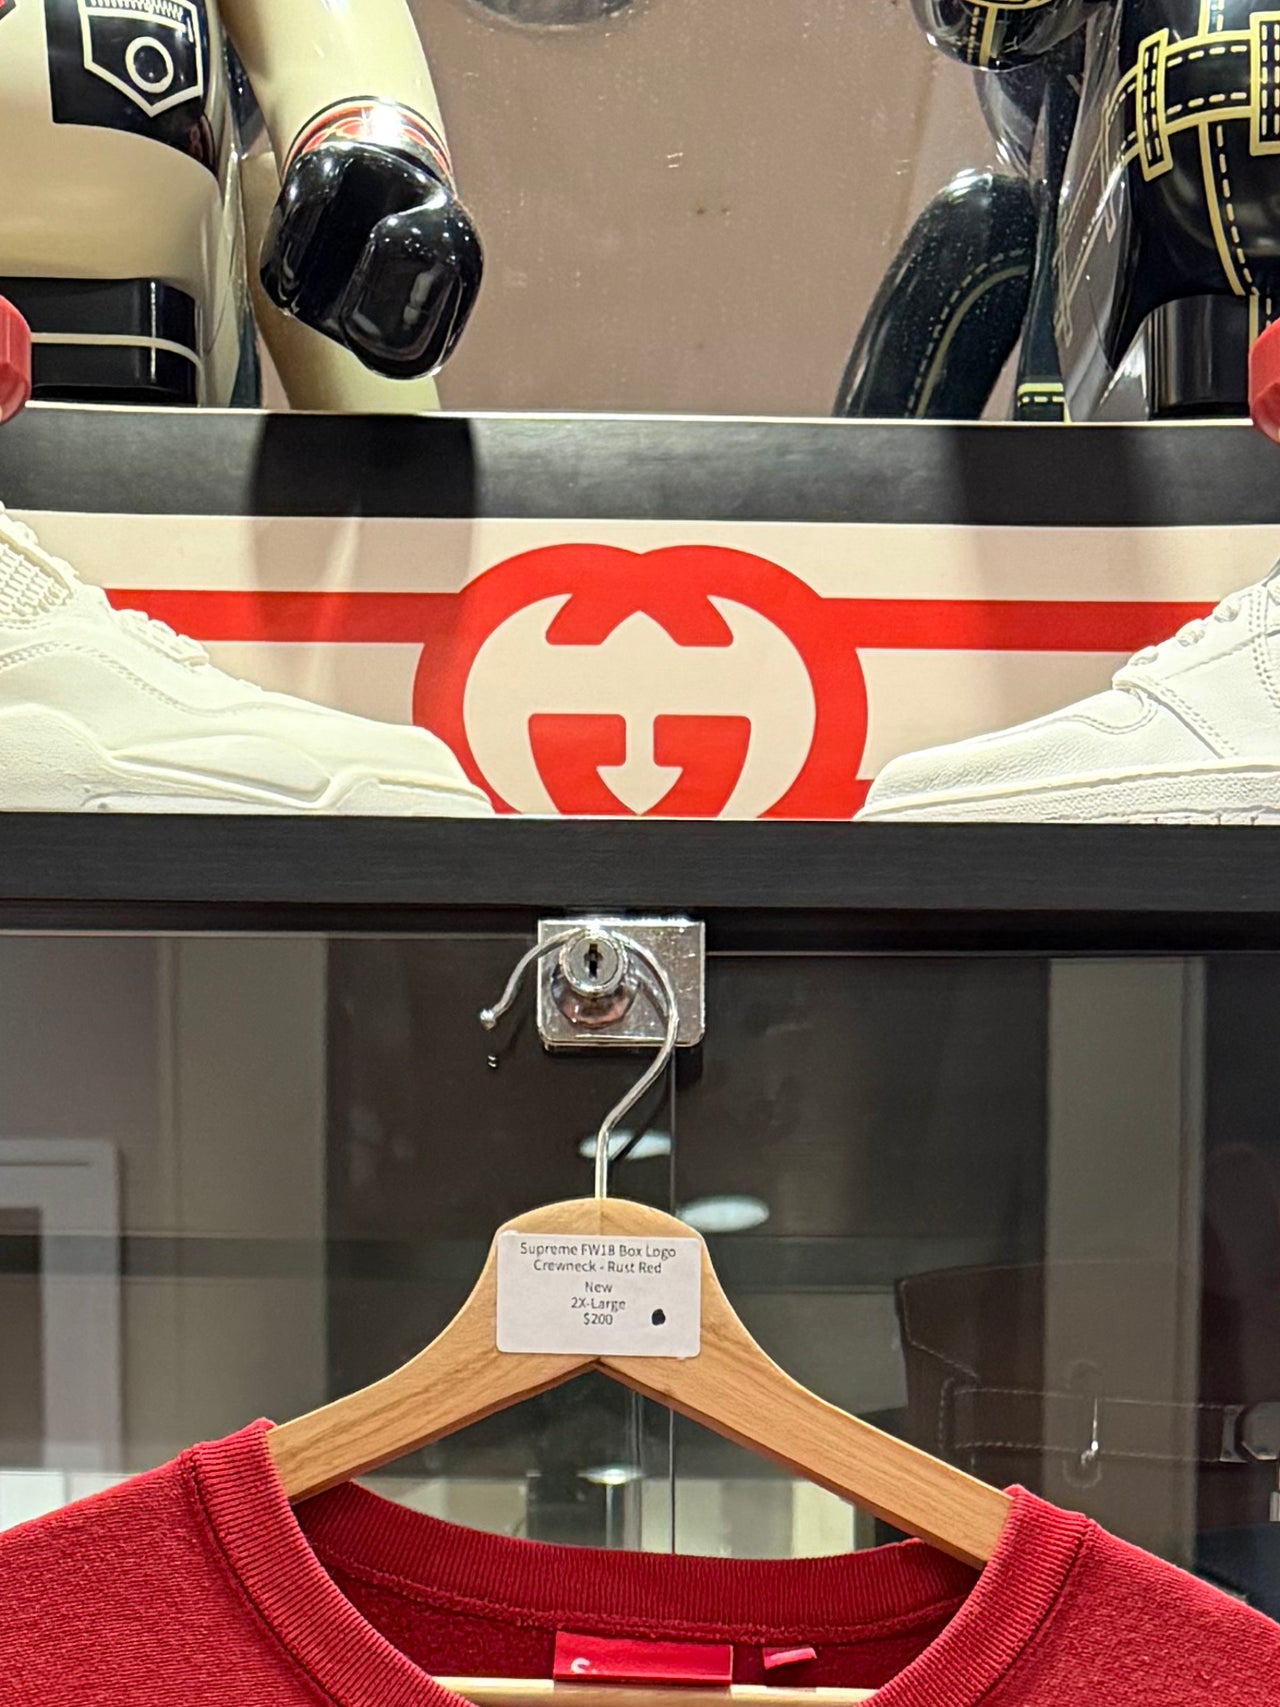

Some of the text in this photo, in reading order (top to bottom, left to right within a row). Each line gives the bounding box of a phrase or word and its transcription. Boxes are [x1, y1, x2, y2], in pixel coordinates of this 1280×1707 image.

[519, 1242, 677, 1261] Supreme FW18 Box Logo
[533, 1259, 597, 1272] Crewneck
[608, 1260, 635, 1273] Rust
[639, 1262, 662, 1274] Red
[585, 1281, 613, 1293] New
[571, 1297, 626, 1312] 2X-Large
[583, 1312, 614, 1326] $200
